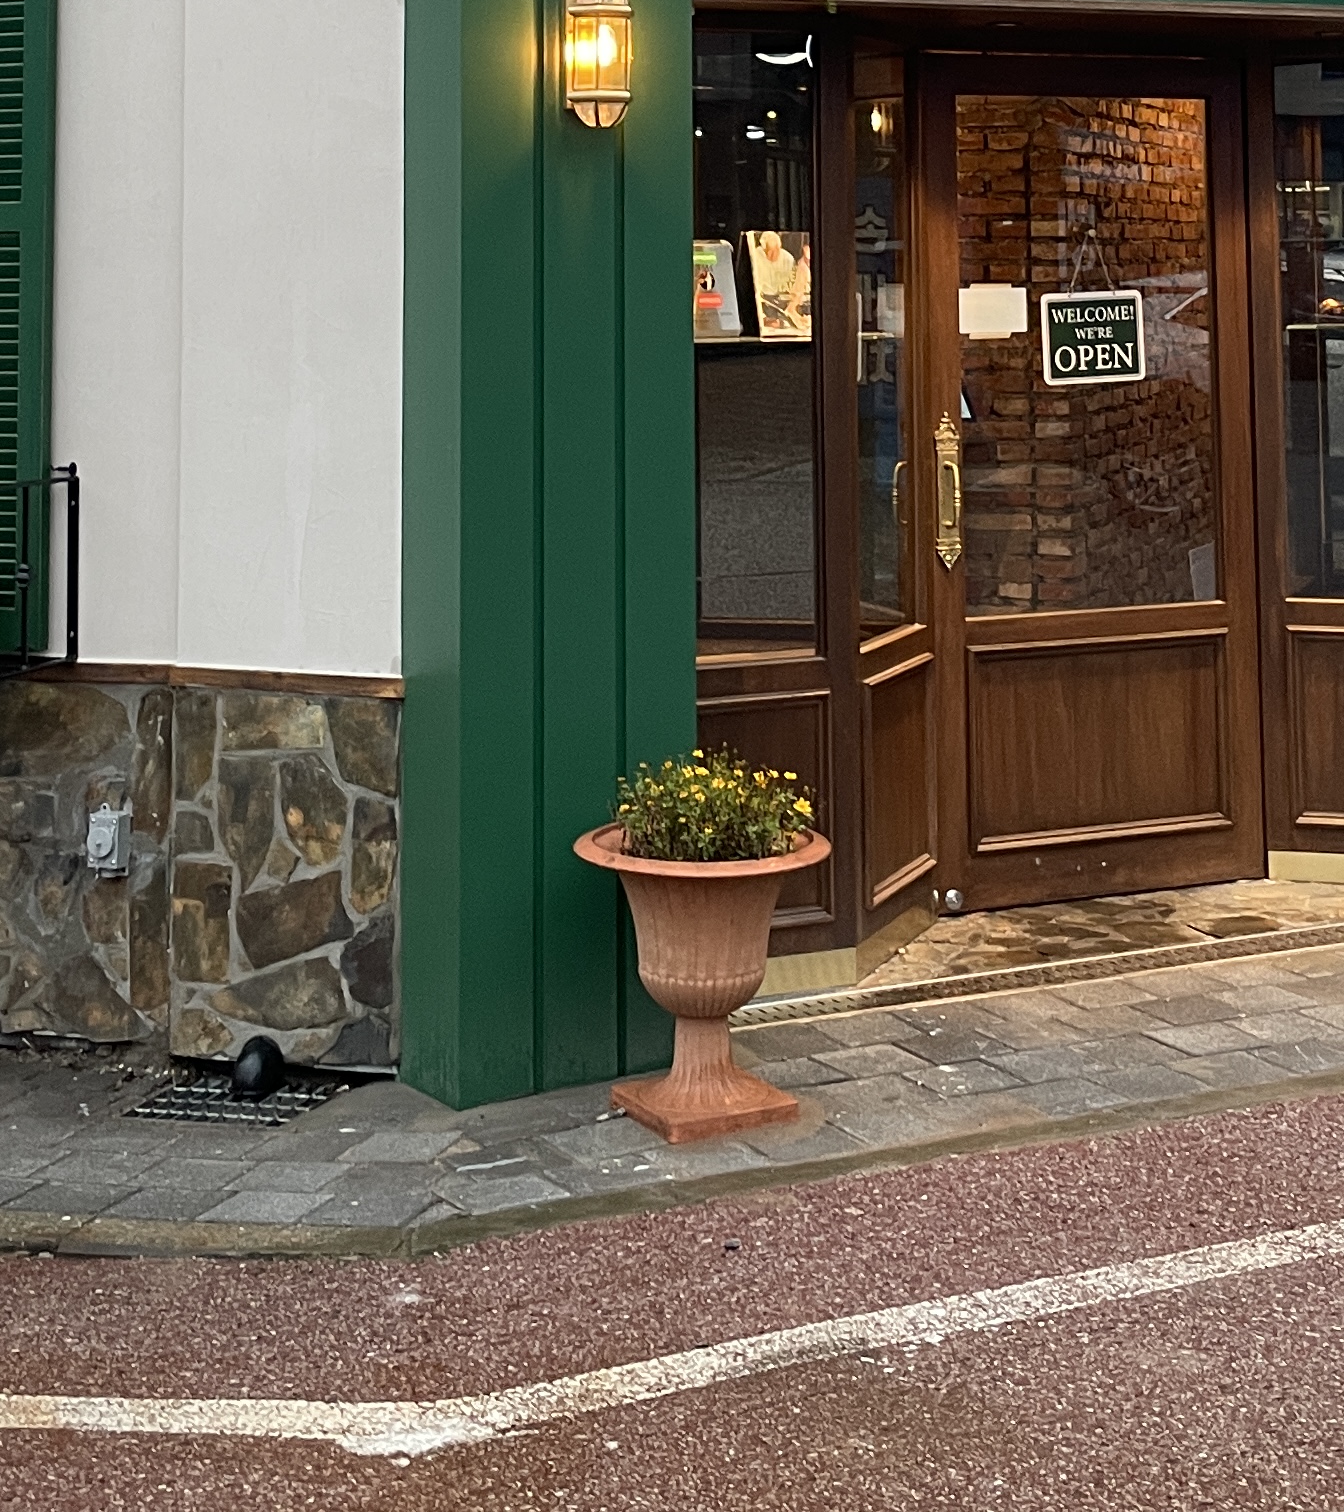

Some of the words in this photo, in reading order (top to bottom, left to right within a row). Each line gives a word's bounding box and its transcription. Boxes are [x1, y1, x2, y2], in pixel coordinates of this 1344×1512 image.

[1051, 304, 1135, 324] WELCOME!
[1074, 326, 1114, 340] WE'RE
[1054, 342, 1134, 372] OPEN
